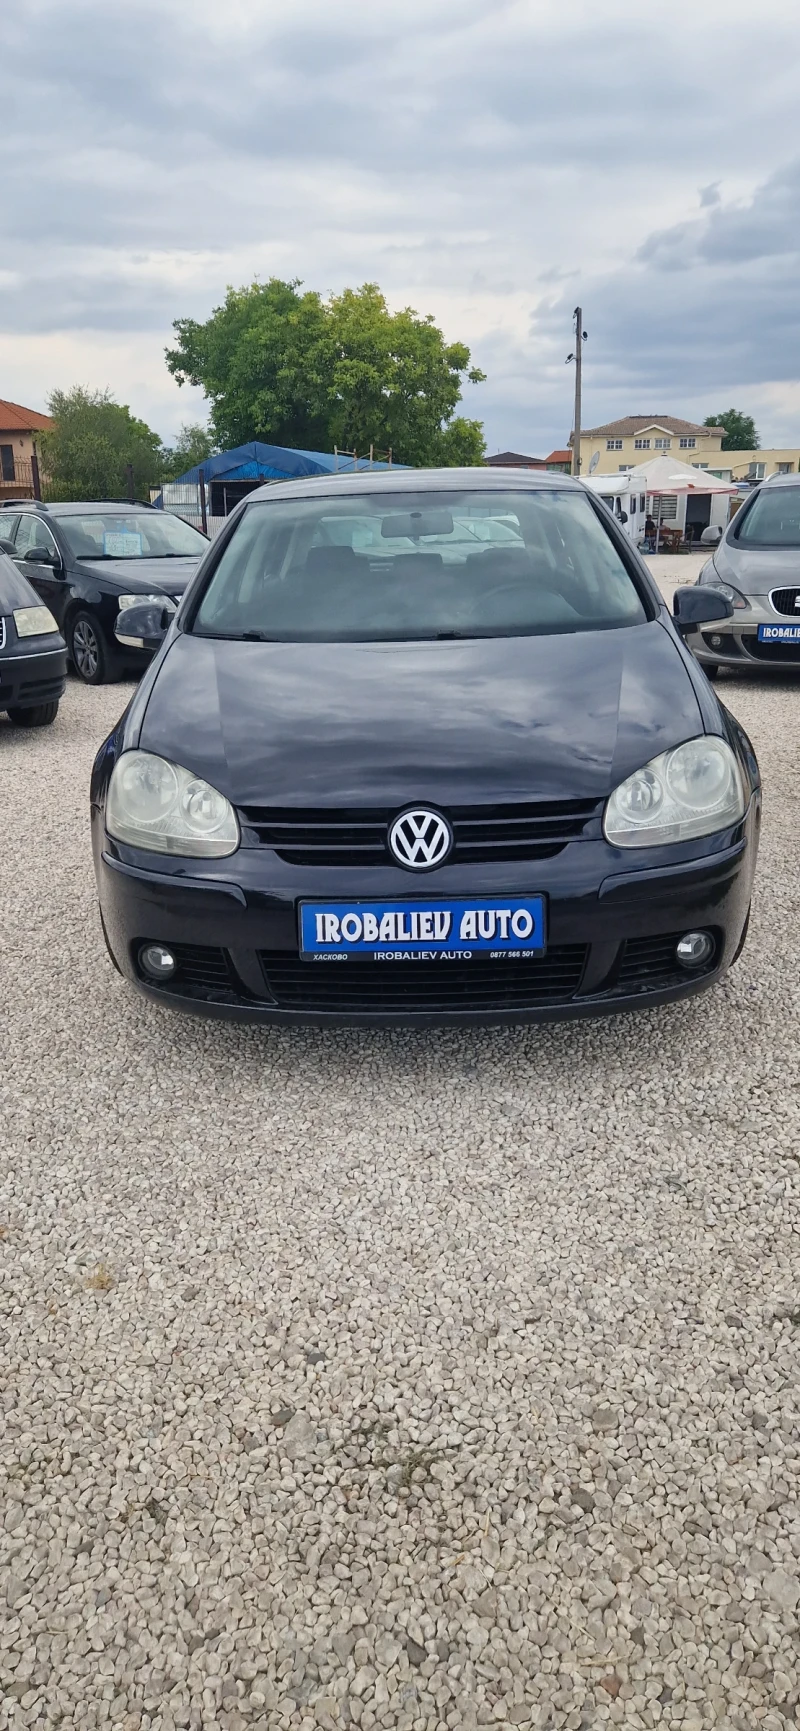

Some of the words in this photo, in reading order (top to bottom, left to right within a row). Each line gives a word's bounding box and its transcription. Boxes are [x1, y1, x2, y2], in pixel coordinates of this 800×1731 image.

[391, 811, 449, 868] VW
[315, 911, 452, 943] IROBALIEV
[460, 909, 533, 940] AUTO
[313, 953, 348, 961] ХАСКОВО
[373, 951, 436, 960] IROBALIEV
[439, 950, 473, 959] AUTO
